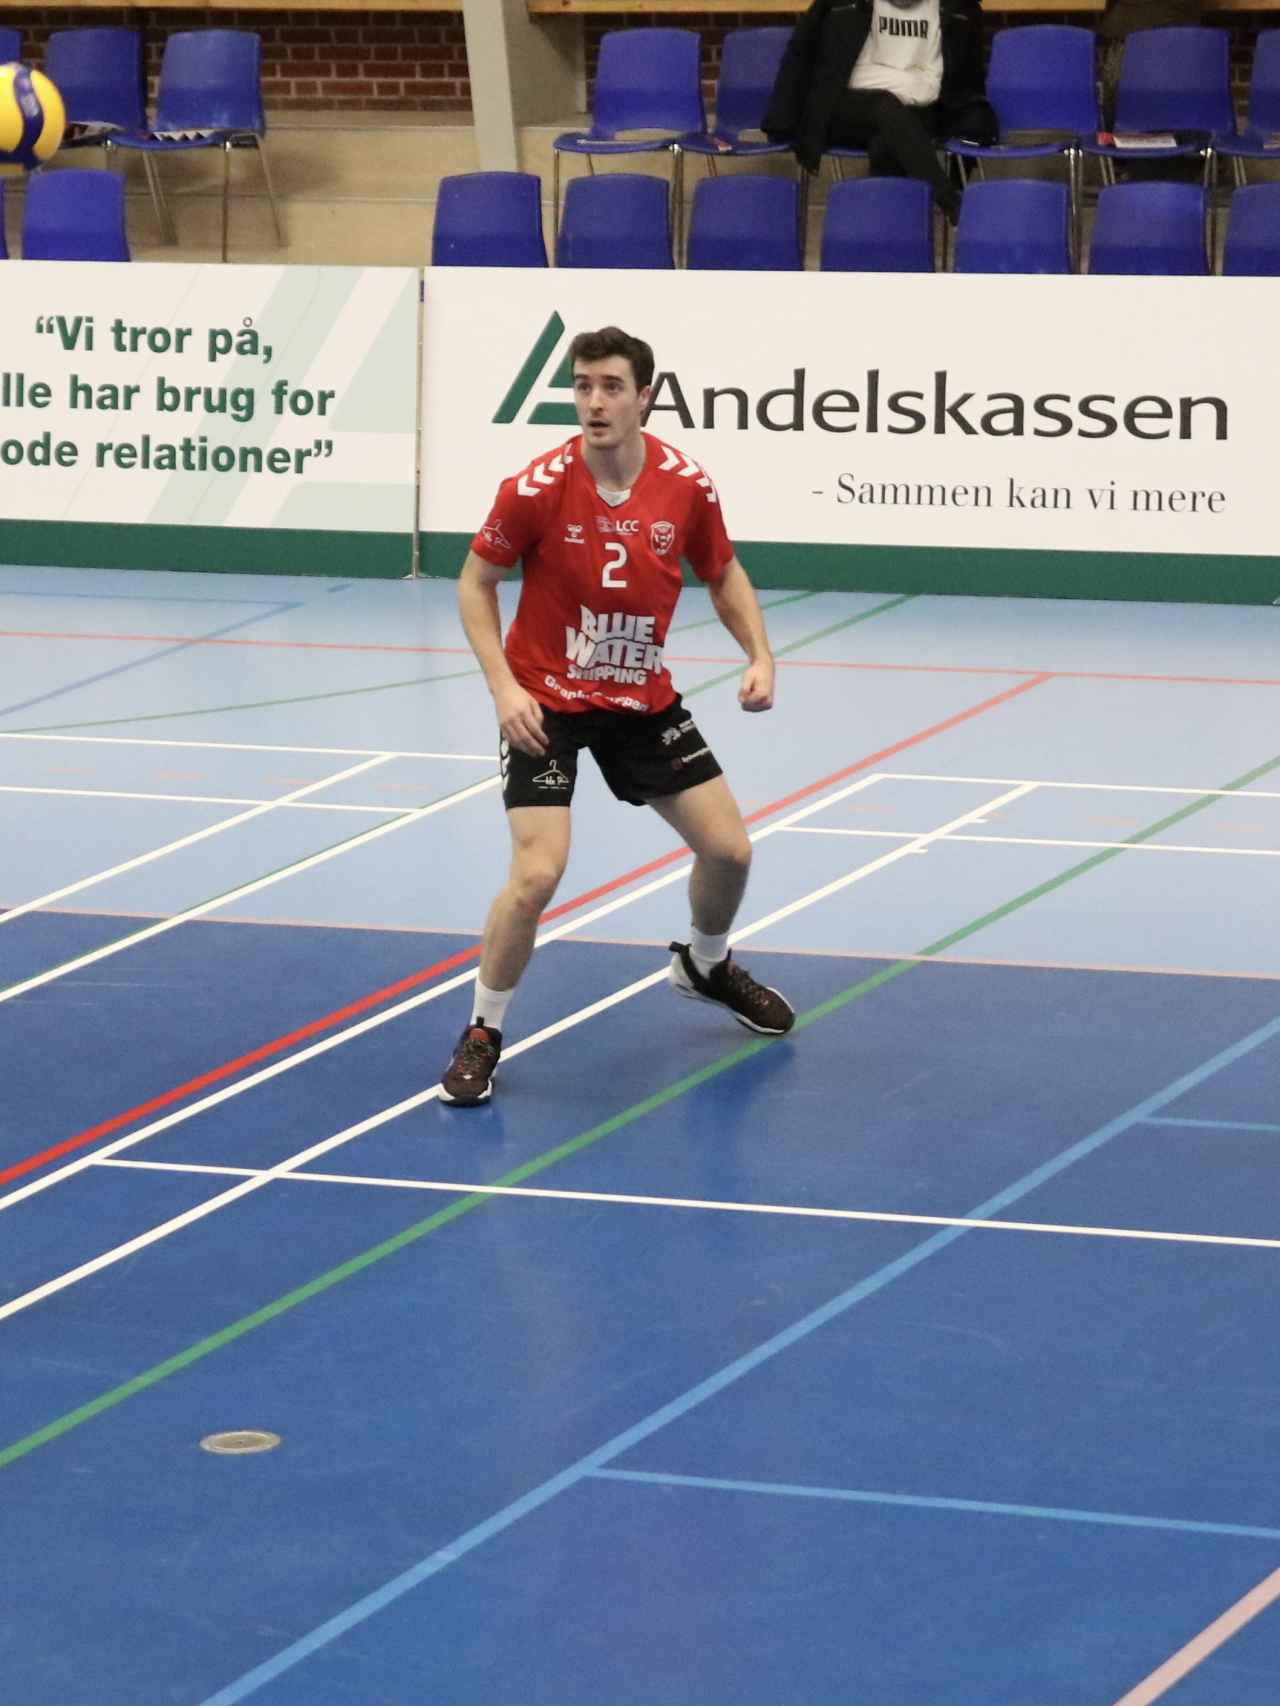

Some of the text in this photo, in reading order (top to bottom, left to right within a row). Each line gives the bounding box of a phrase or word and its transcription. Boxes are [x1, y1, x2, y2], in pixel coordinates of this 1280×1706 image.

[879, 16, 928, 40] PUMA
[111, 318, 193, 353] tror
[208, 316, 274, 364] på,
[68, 374, 140, 411] har
[156, 376, 256, 423] brug
[271, 379, 336, 417] for
[641, 367, 1229, 441] Andelskassen
[835, 473, 995, 507] Sammen
[1007, 477, 1075, 512] kan
[1084, 479, 1118, 512] vi
[1129, 485, 1227, 515] mere
[616, 519, 640, 533] LCC
[602, 542, 628, 588] 2
[580, 604, 656, 646] BLUE
[565, 626, 664, 675] WATER
